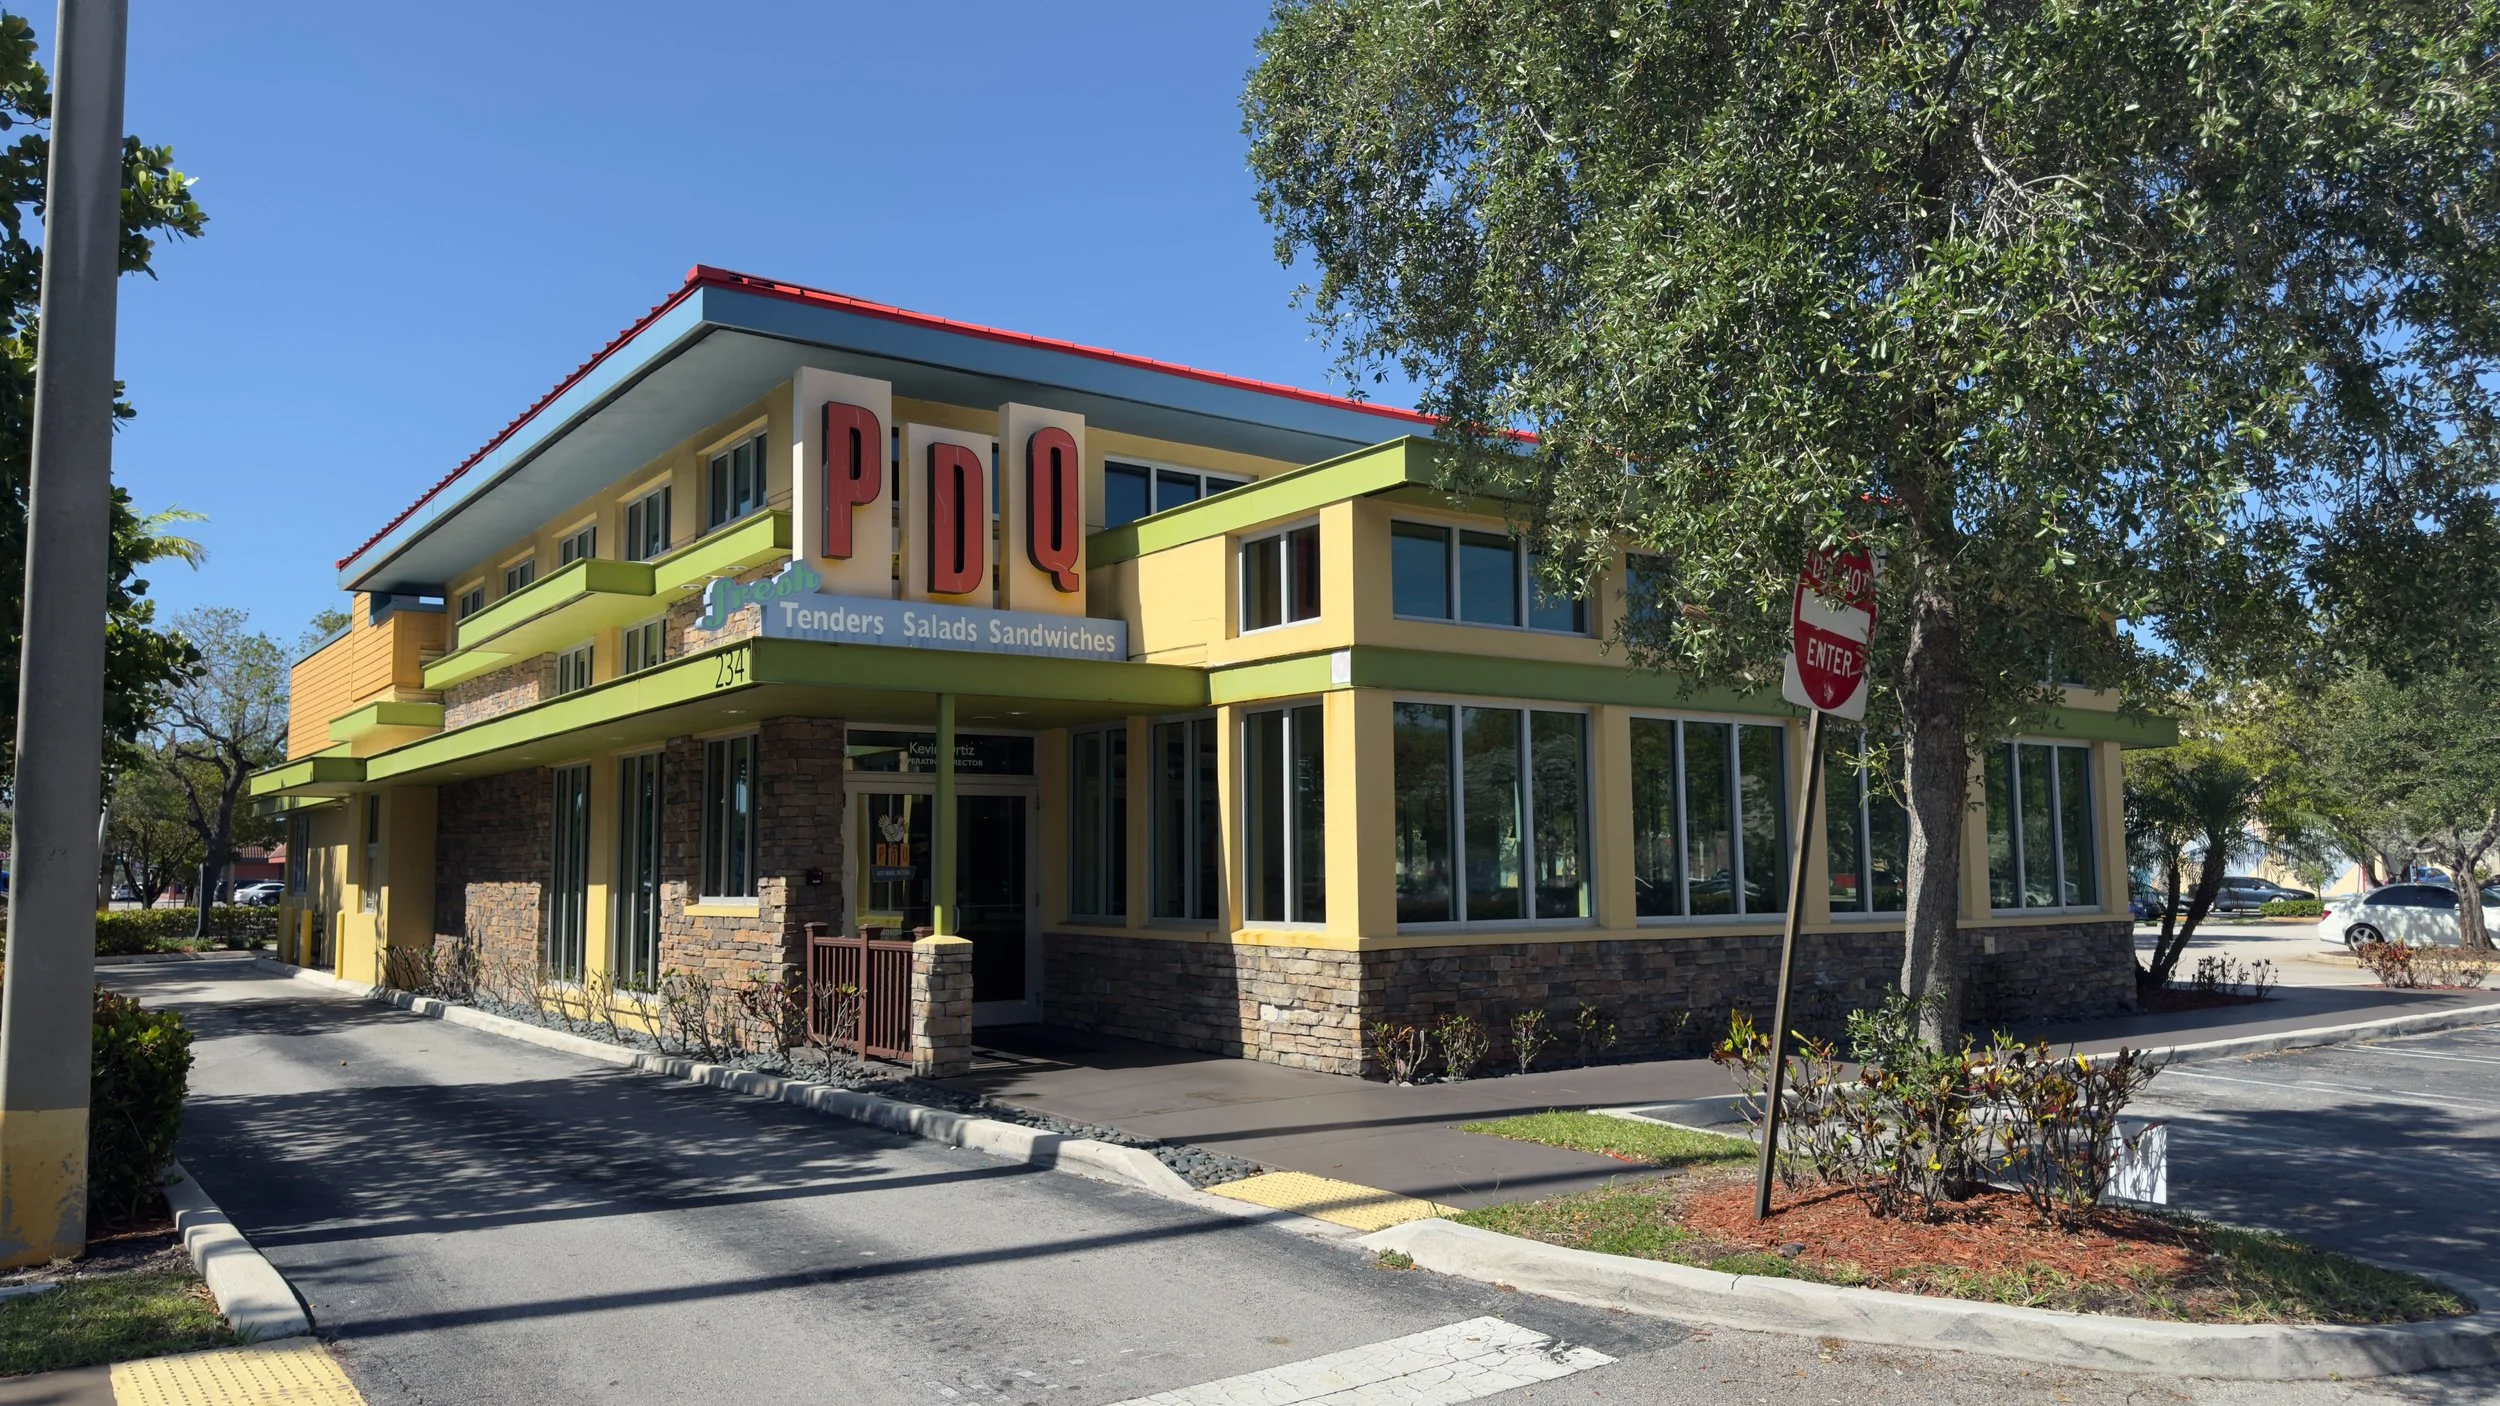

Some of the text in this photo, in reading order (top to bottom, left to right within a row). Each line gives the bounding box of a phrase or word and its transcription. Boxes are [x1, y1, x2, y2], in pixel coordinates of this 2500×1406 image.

[822, 401, 1079, 594] PDQ
[701, 560, 820, 629] fresh
[780, 601, 1116, 653] Tenders Salads Sandwiches
[715, 647, 745, 689] 234
[1806, 637, 1853, 679] ENTER
[953, 744, 976, 756] rtiz
